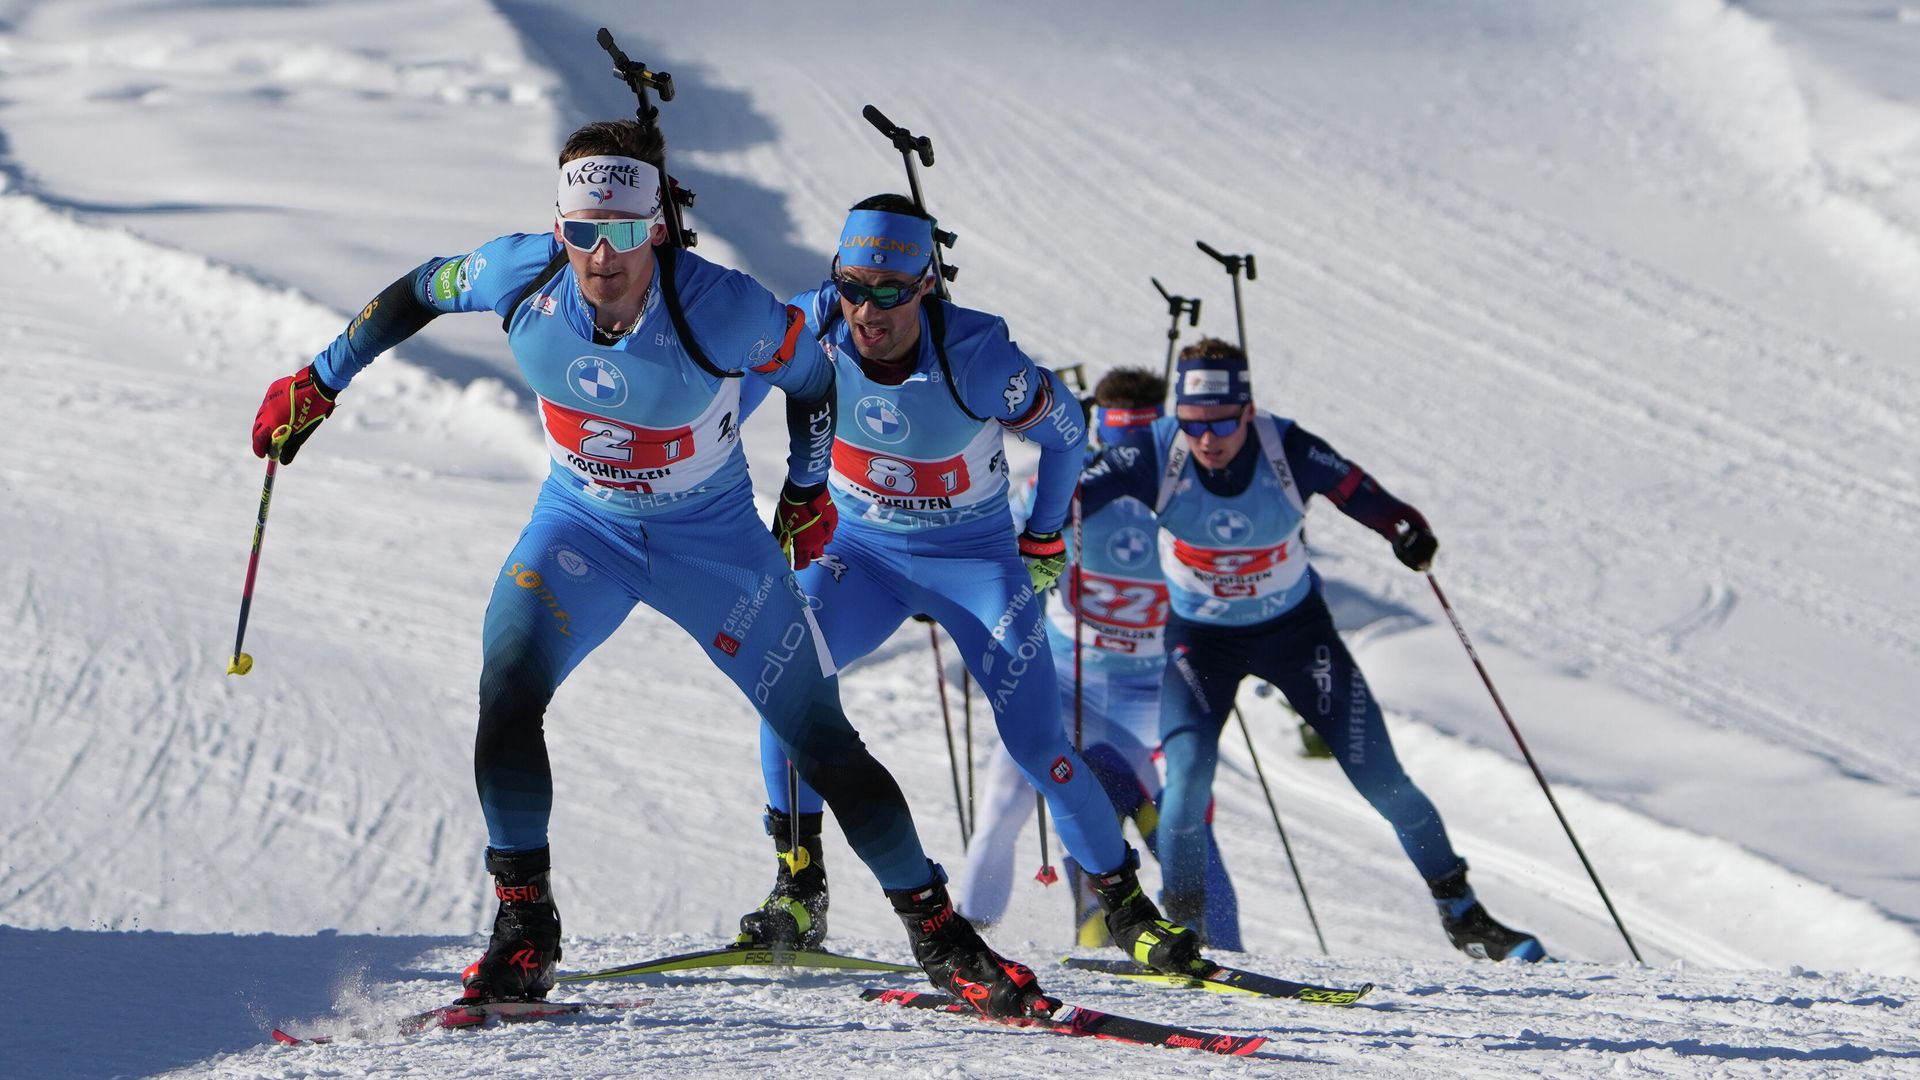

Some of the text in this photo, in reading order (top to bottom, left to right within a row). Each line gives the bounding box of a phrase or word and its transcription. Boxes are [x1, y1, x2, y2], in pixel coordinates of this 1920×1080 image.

[567, 170, 641, 189] VAGNE
[844, 235, 921, 256] LIVIGNO
[577, 359, 621, 380] BMW
[580, 419, 681, 461] 2 1
[807, 402, 831, 477] RANCE
[1049, 403, 1083, 446] Audi
[866, 457, 957, 494] 8 1
[723, 595, 750, 633] CAISSE
[988, 584, 1033, 650] sportful
[1081, 579, 1157, 624] 22
[755, 622, 805, 705] odlo
[1311, 644, 1332, 715] odlo
[744, 952, 797, 965] FISCER
